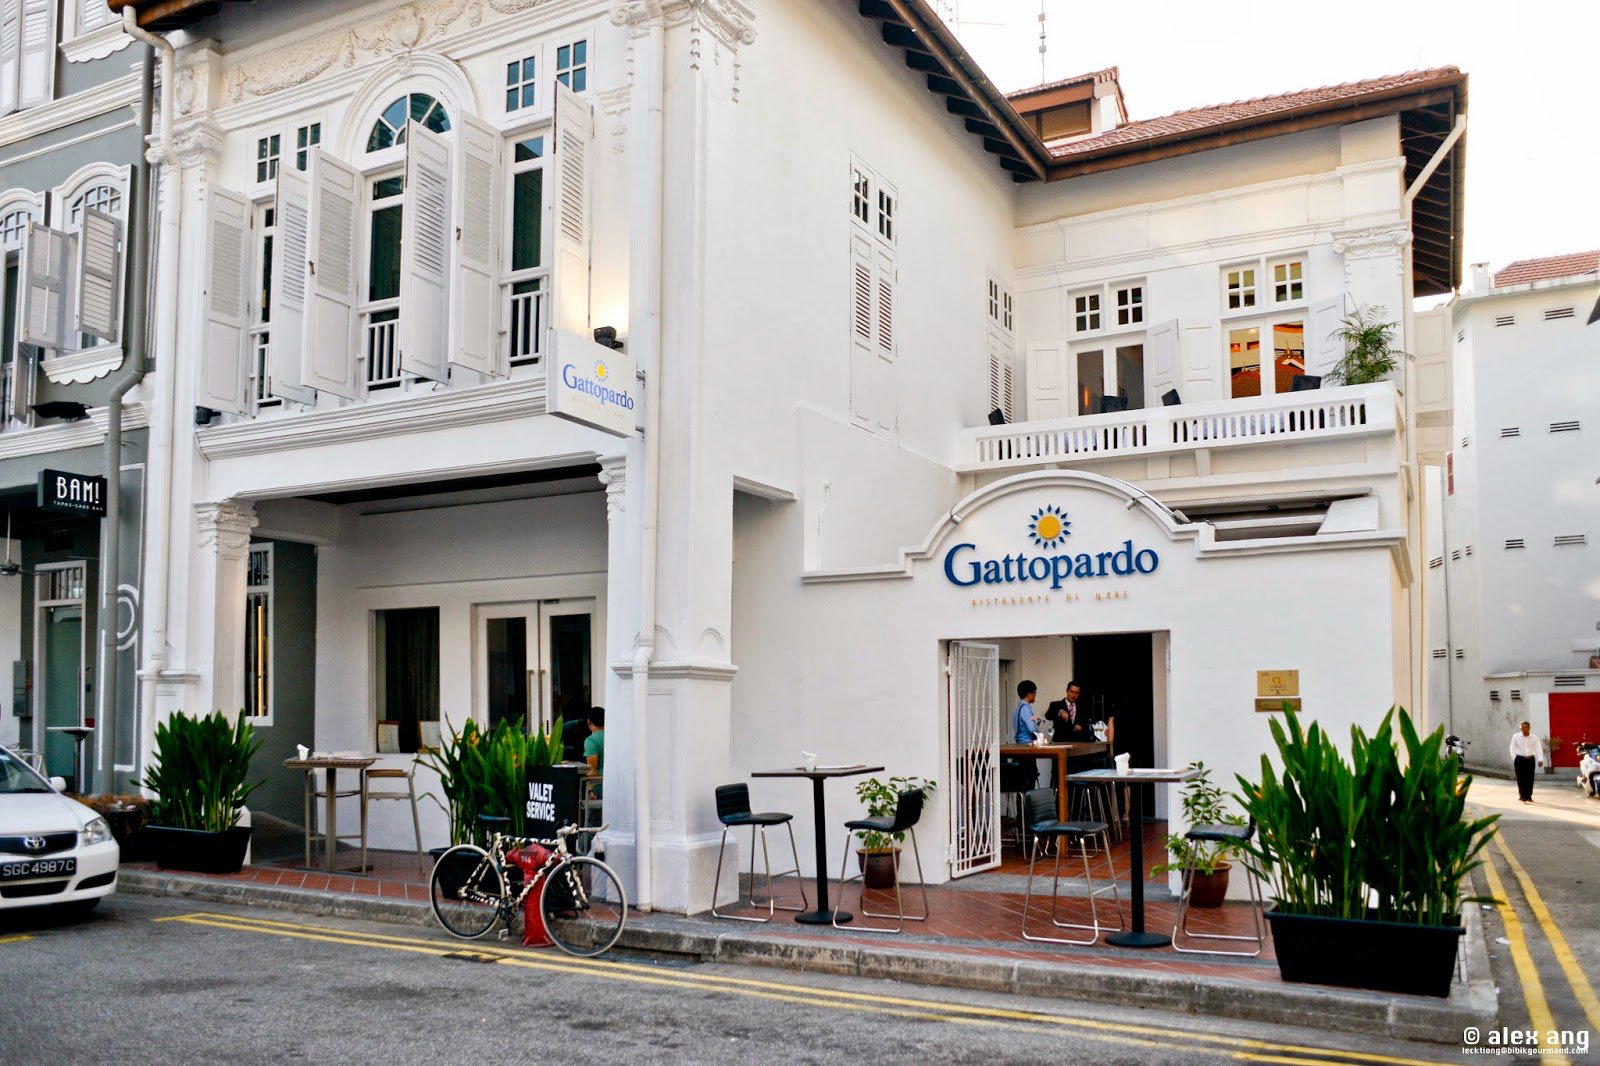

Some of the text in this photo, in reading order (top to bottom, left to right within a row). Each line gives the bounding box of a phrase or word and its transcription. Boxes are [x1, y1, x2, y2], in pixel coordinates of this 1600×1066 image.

[562, 364, 634, 411] Gattopardo
[56, 476, 100, 504] BAM!
[944, 539, 1159, 590] Gattopardo
[528, 781, 554, 802] VALET
[526, 800, 556, 822] SERVICE
